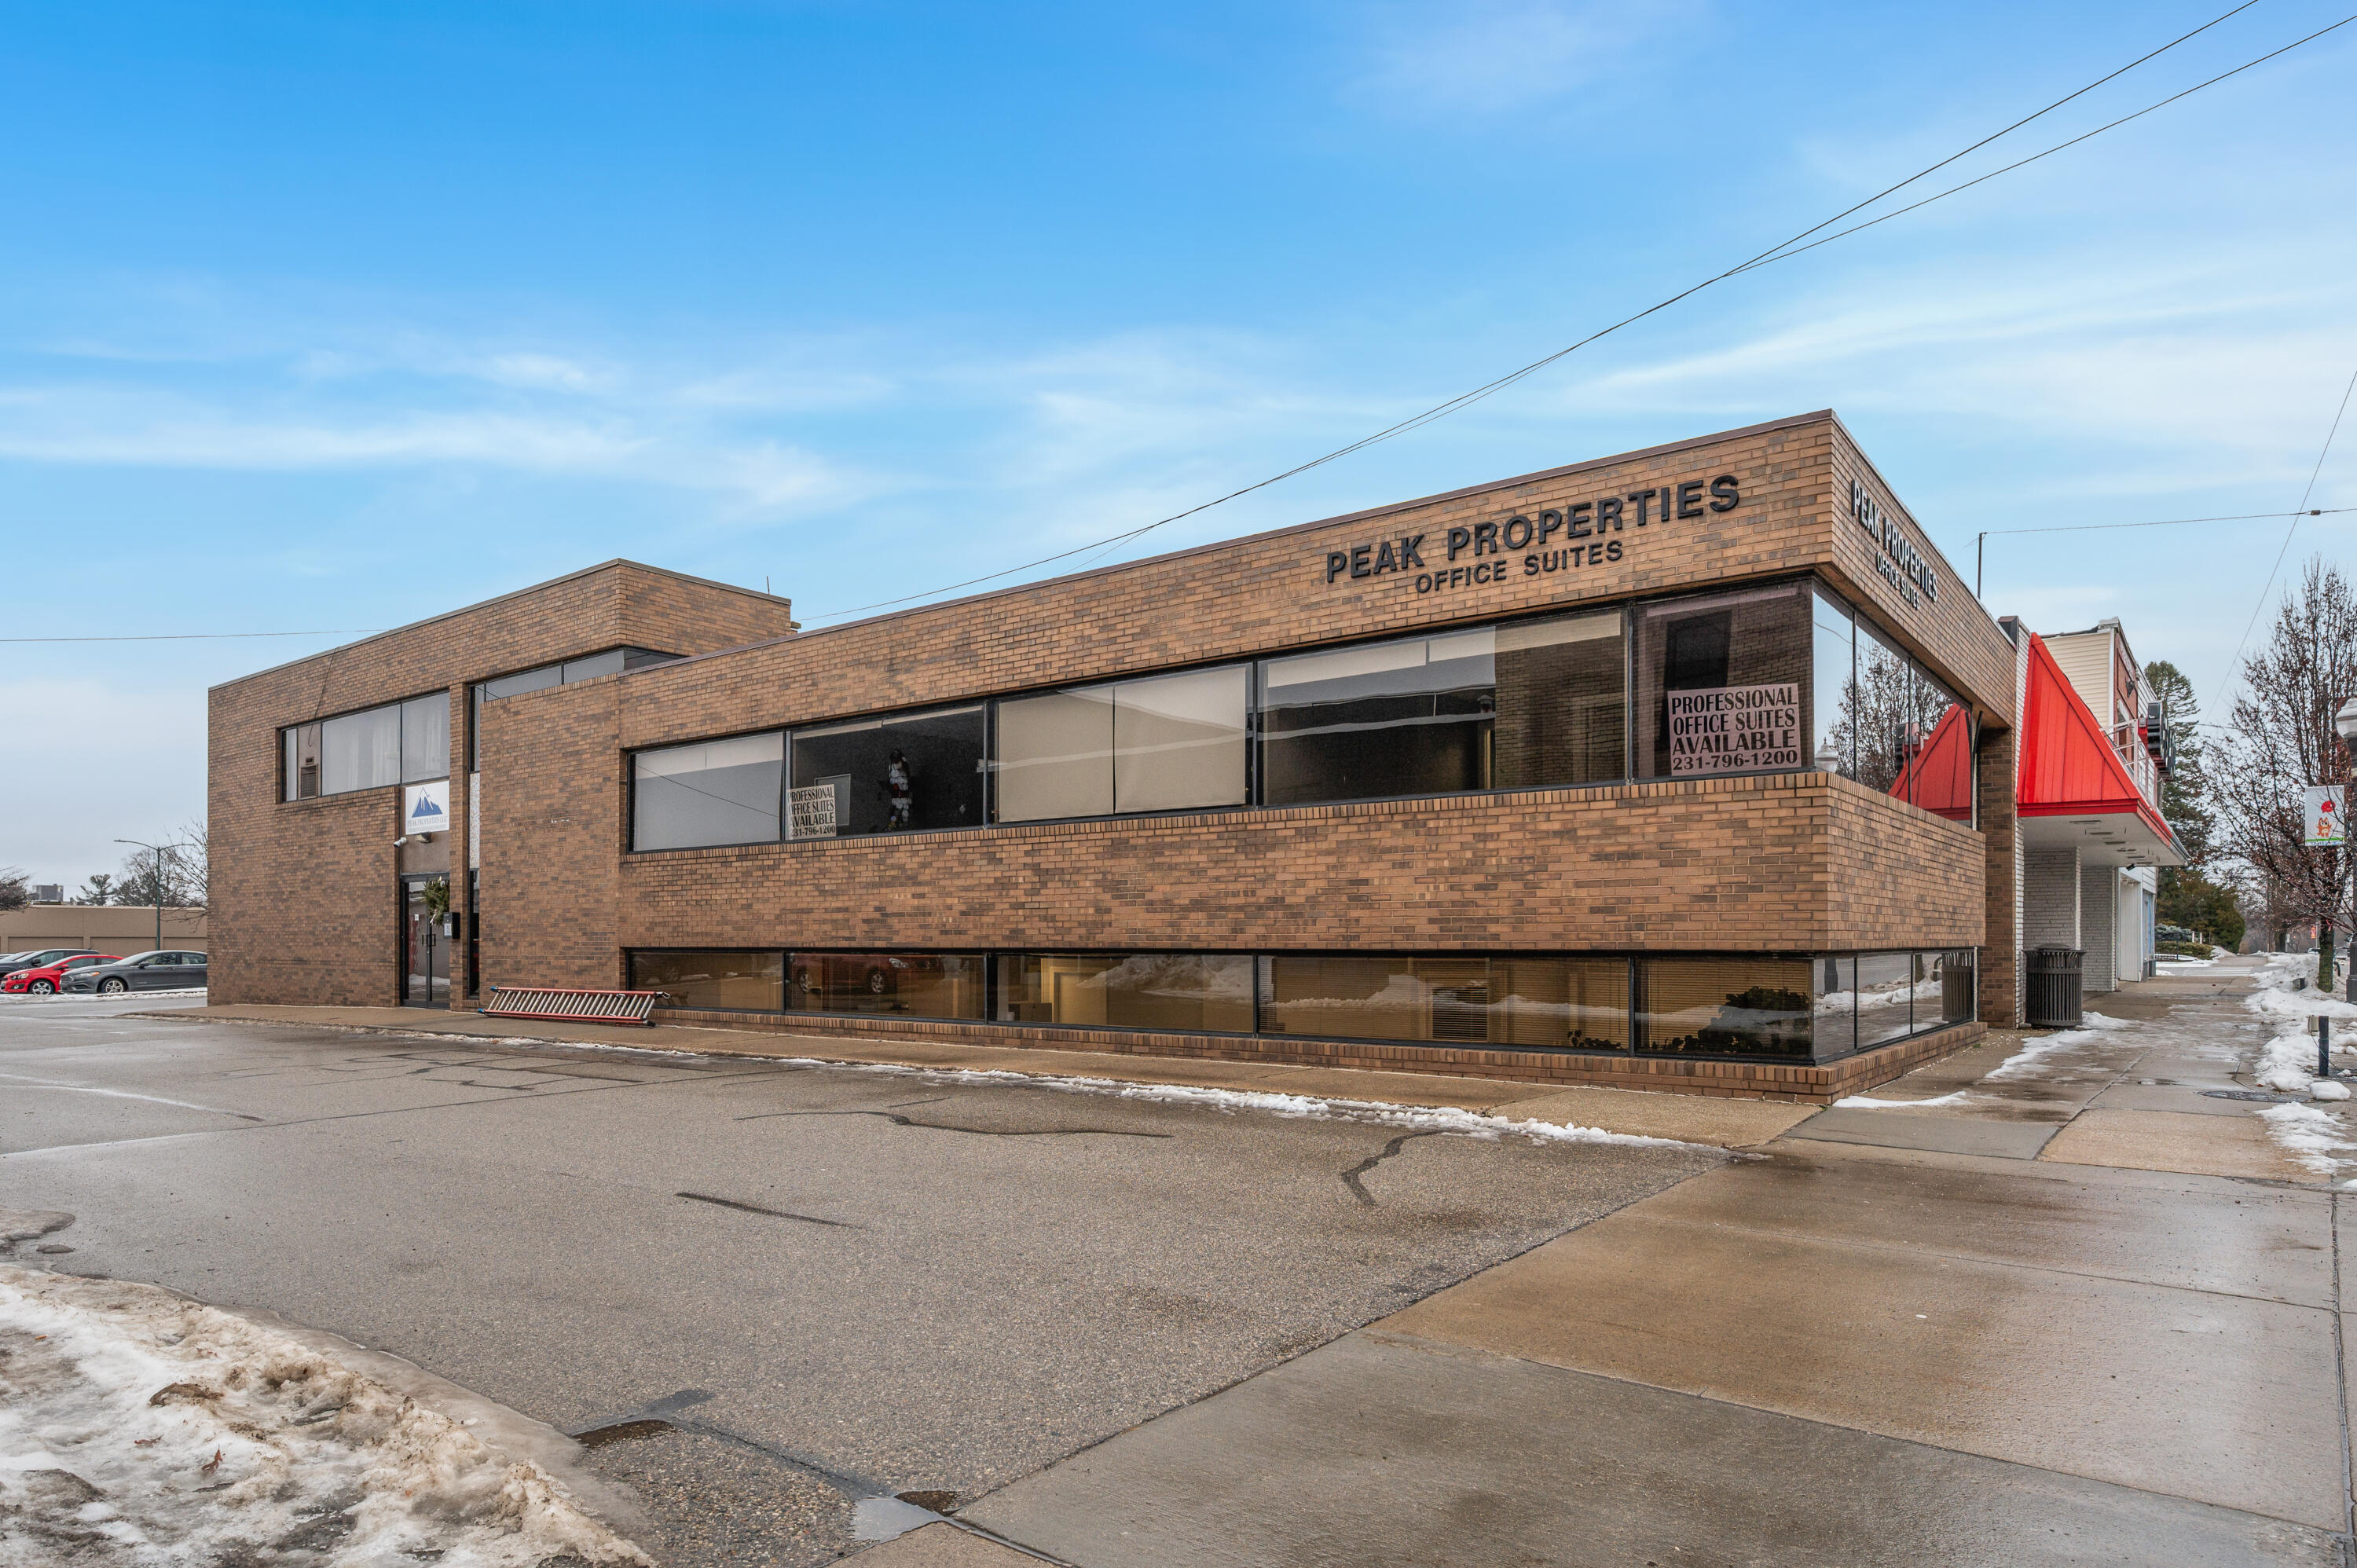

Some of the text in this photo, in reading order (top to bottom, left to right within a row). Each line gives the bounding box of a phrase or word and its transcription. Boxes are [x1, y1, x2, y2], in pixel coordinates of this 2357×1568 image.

[1327, 474, 1739, 582] PEAK PROPERTIES
[1851, 479, 1938, 603] PEAK PROPERTIES
[1415, 540, 1623, 593] OFFICE SUITES
[1876, 551, 1920, 610] OFFICE SUITES
[1672, 687, 1798, 715] PROFESSIONAL
[1673, 709, 1795, 735] OFFICE SUITES
[1673, 729, 1797, 756] AVAILABLE
[1673, 750, 1798, 771] 231-796-1200
[788, 786, 834, 802] PROFESSIONAL
[812, 799, 834, 813] SUITES
